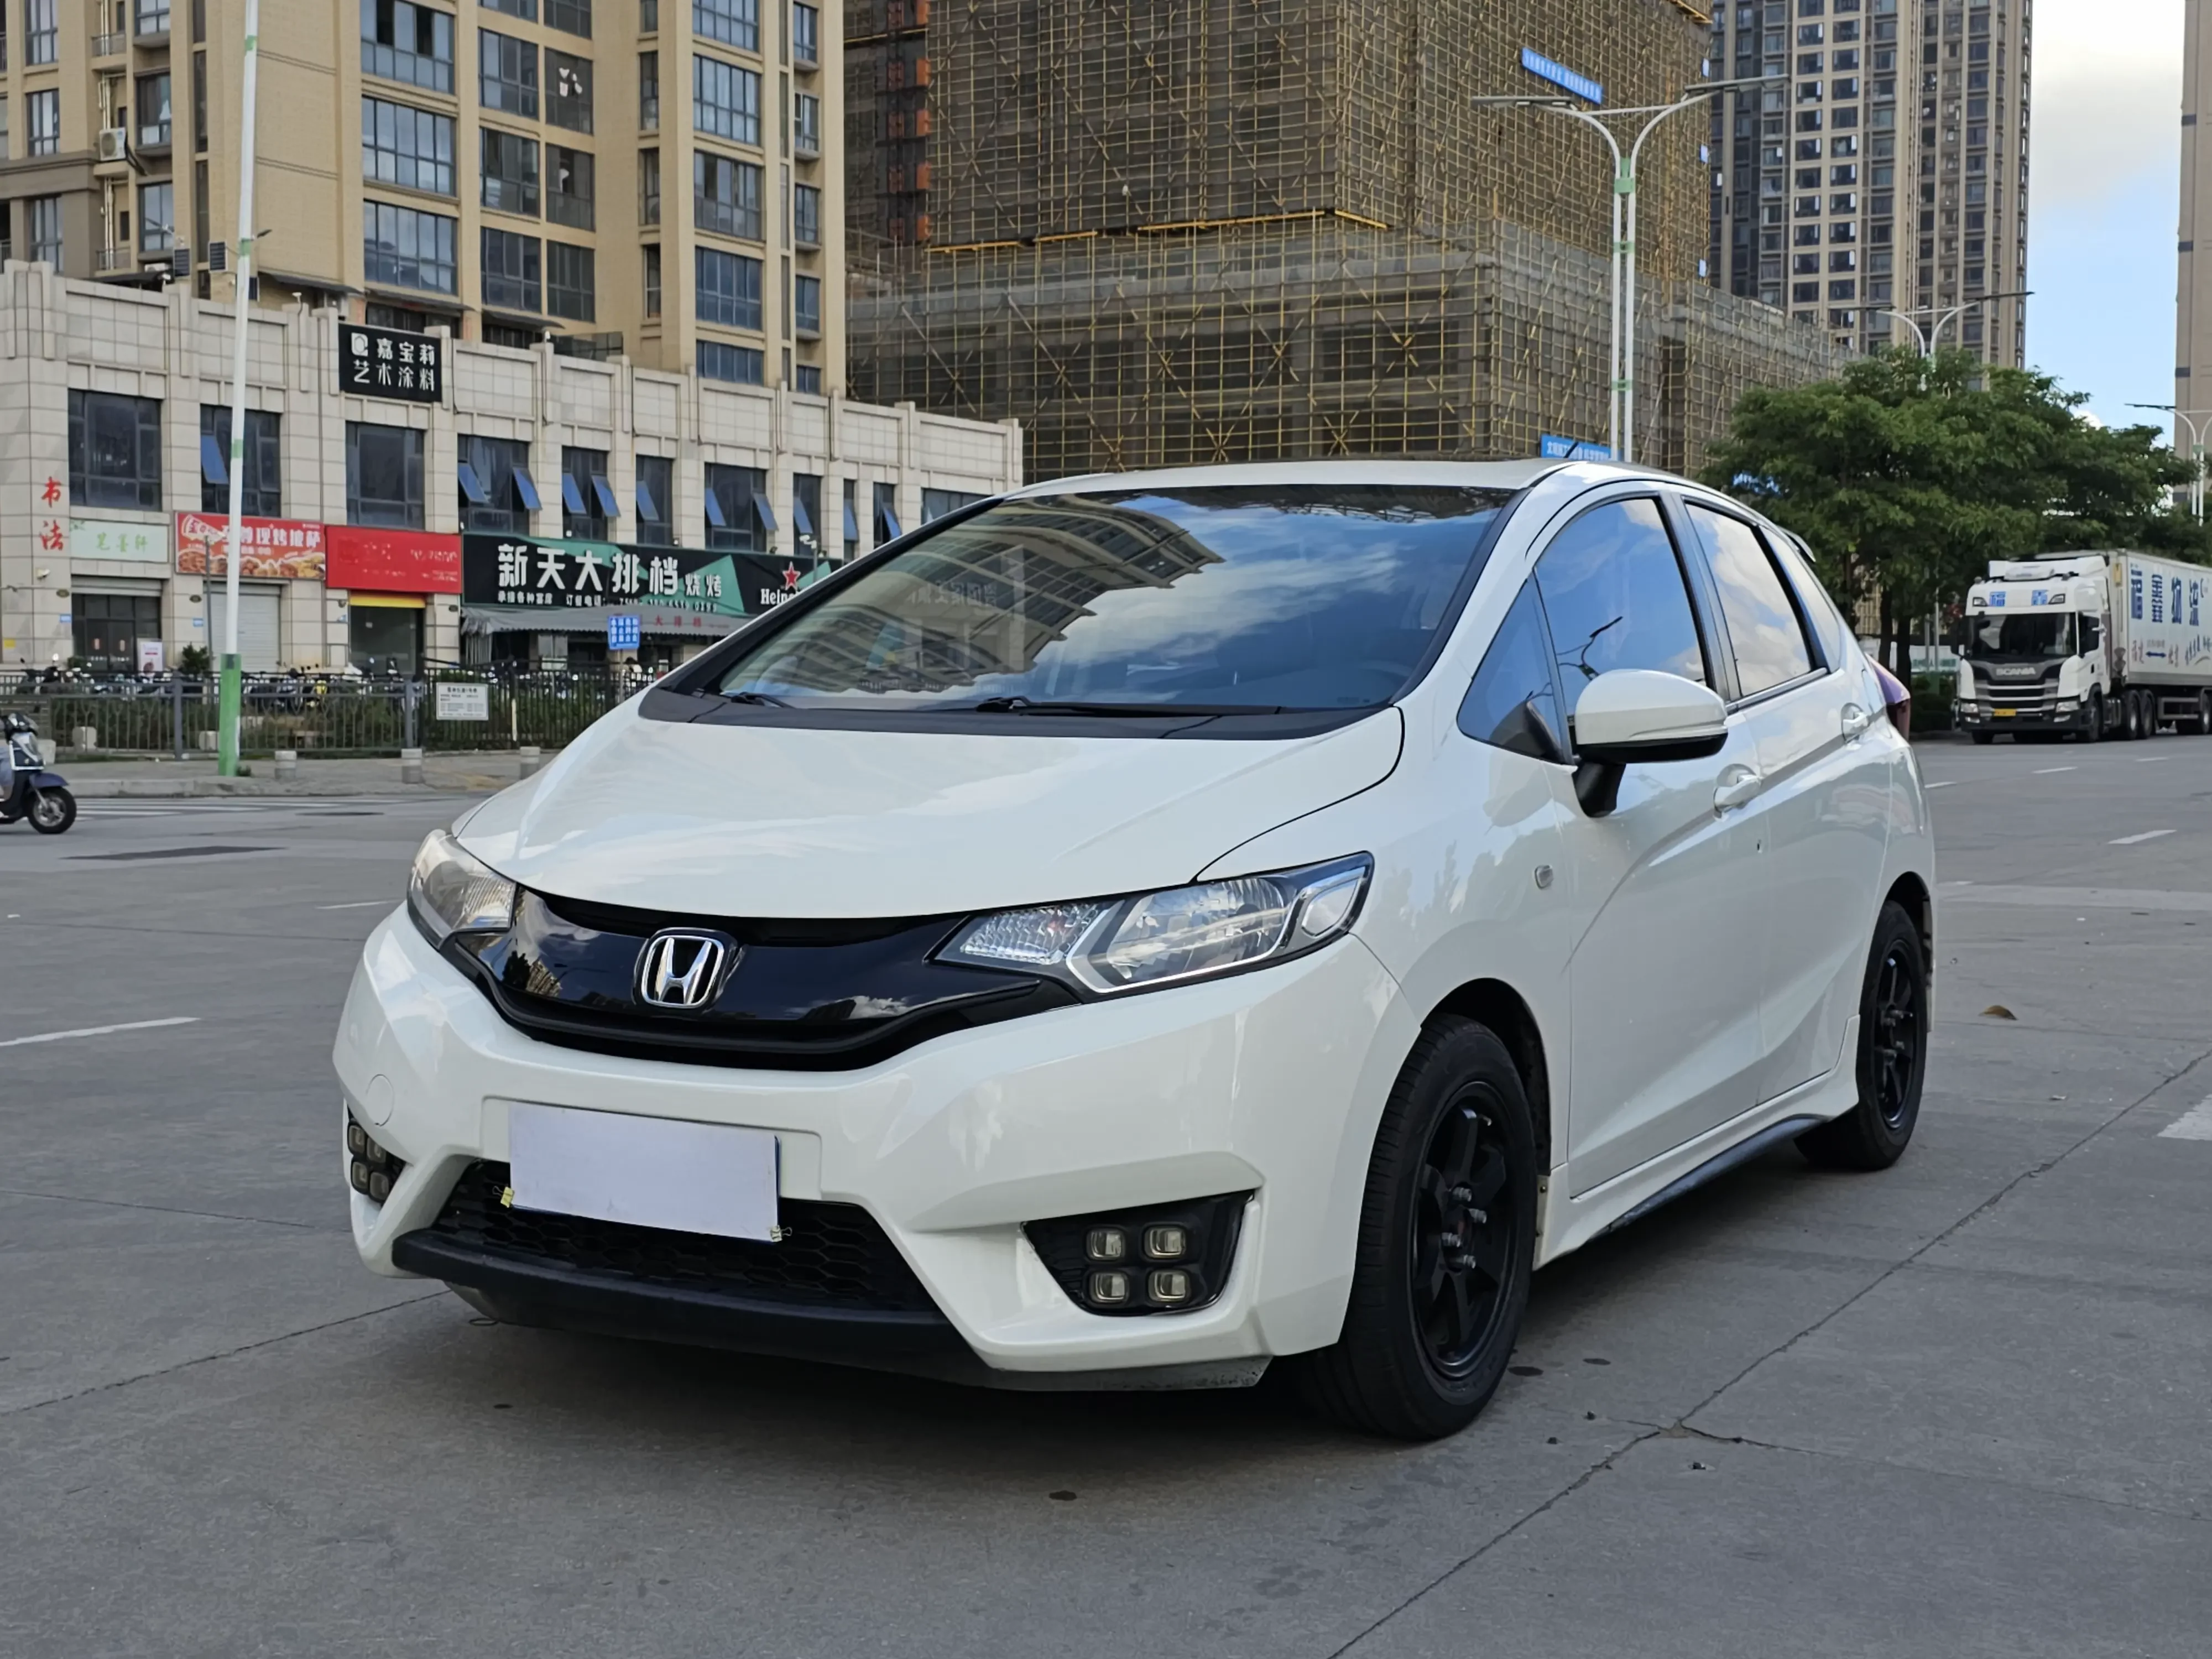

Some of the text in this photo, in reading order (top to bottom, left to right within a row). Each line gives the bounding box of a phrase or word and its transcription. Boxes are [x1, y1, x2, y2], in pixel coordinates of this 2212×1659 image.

[353, 359, 435, 392] 艺术涂料
[498, 543, 679, 596] 新天大排档
[684, 573, 722, 598] 烧烤
